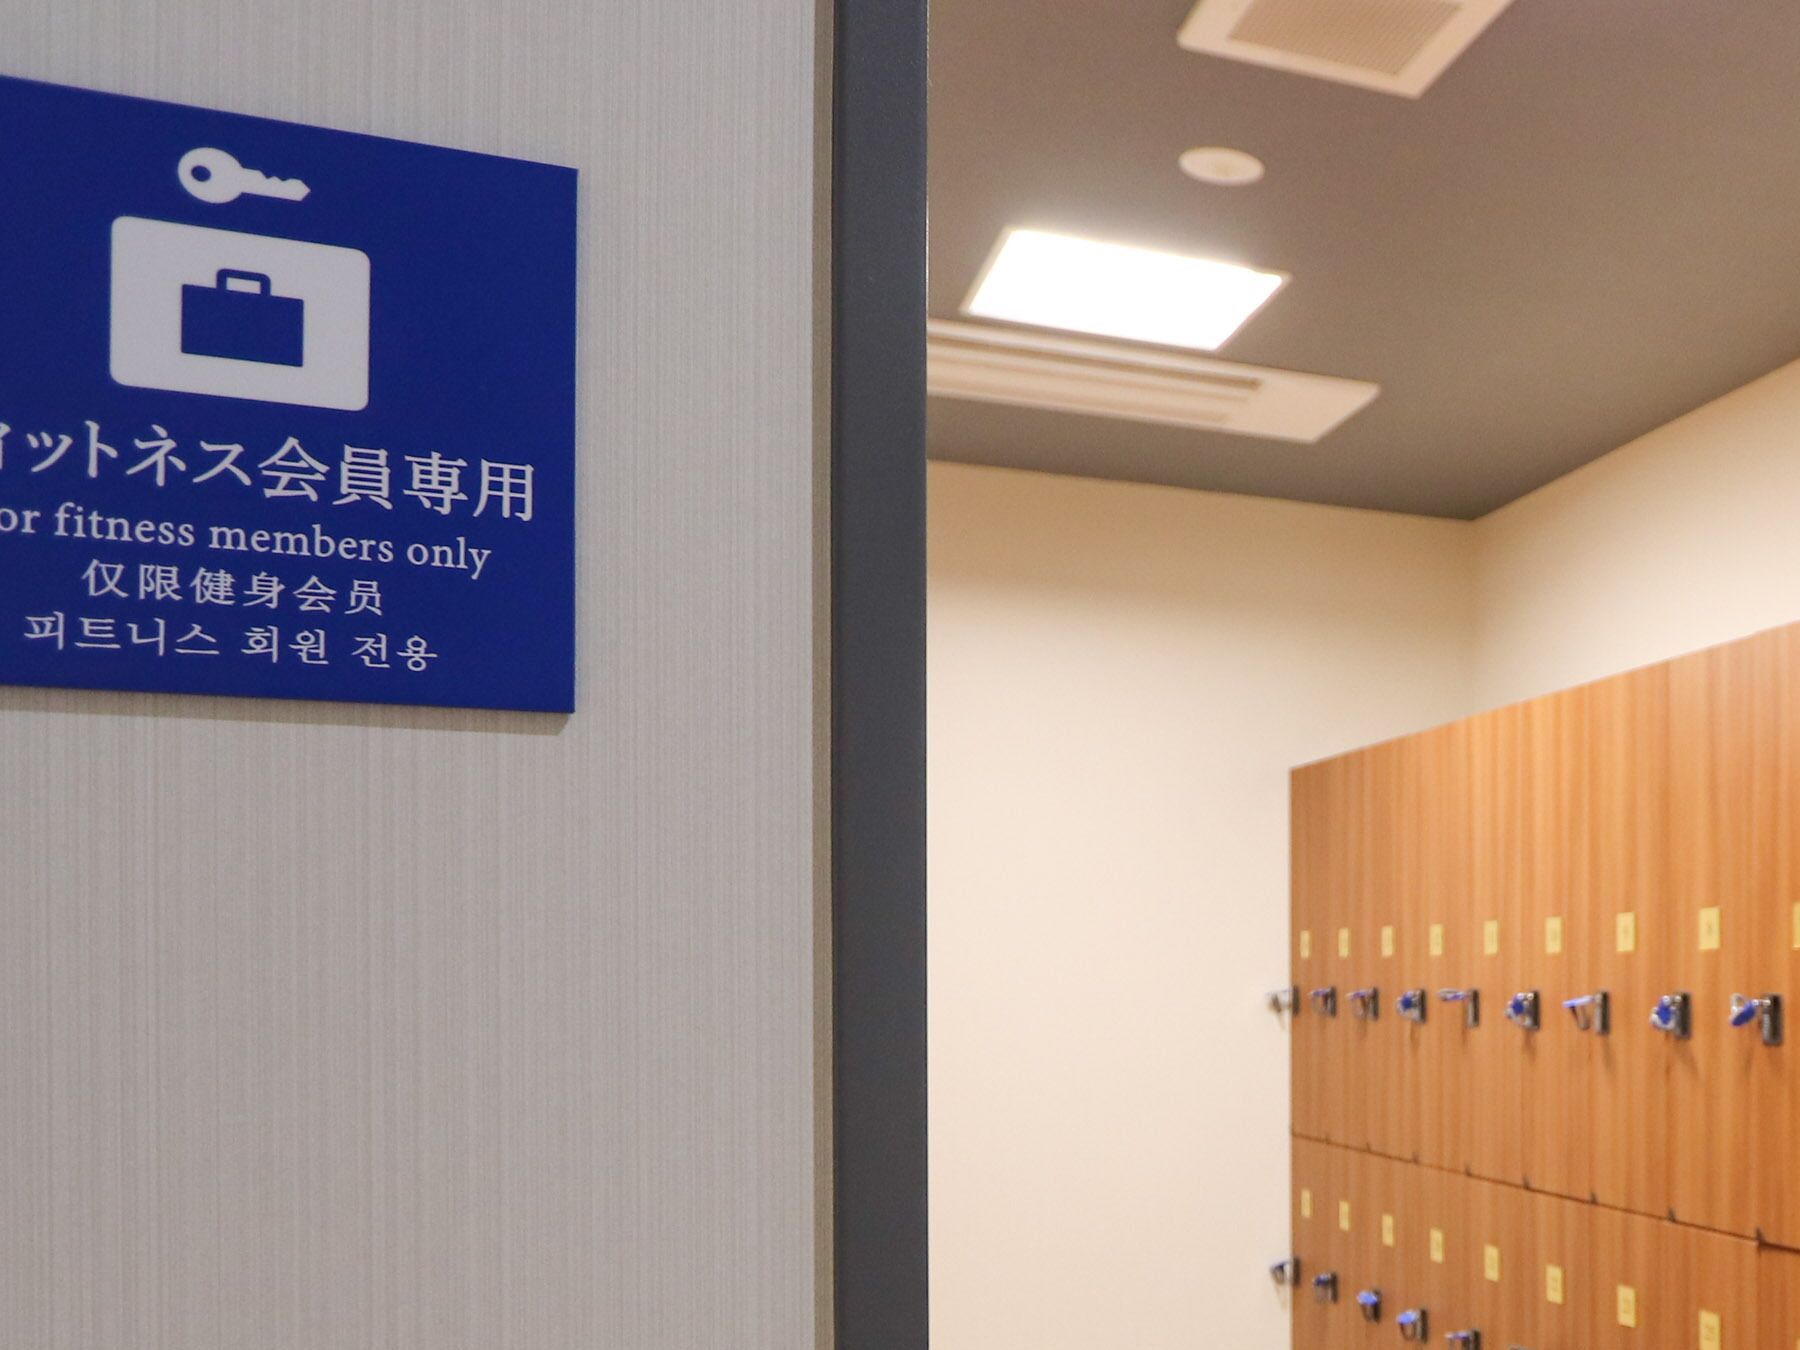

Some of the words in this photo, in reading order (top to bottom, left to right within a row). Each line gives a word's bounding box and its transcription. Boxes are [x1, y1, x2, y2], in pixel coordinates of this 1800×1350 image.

[54, 501, 195, 546] fitness
[208, 523, 394, 562] members
[407, 536, 492, 580] only
[82, 558, 383, 616] 仅限健身会员
[24, 610, 220, 656] 피트니스
[241, 624, 330, 666] 회원
[352, 631, 438, 672] 전용
